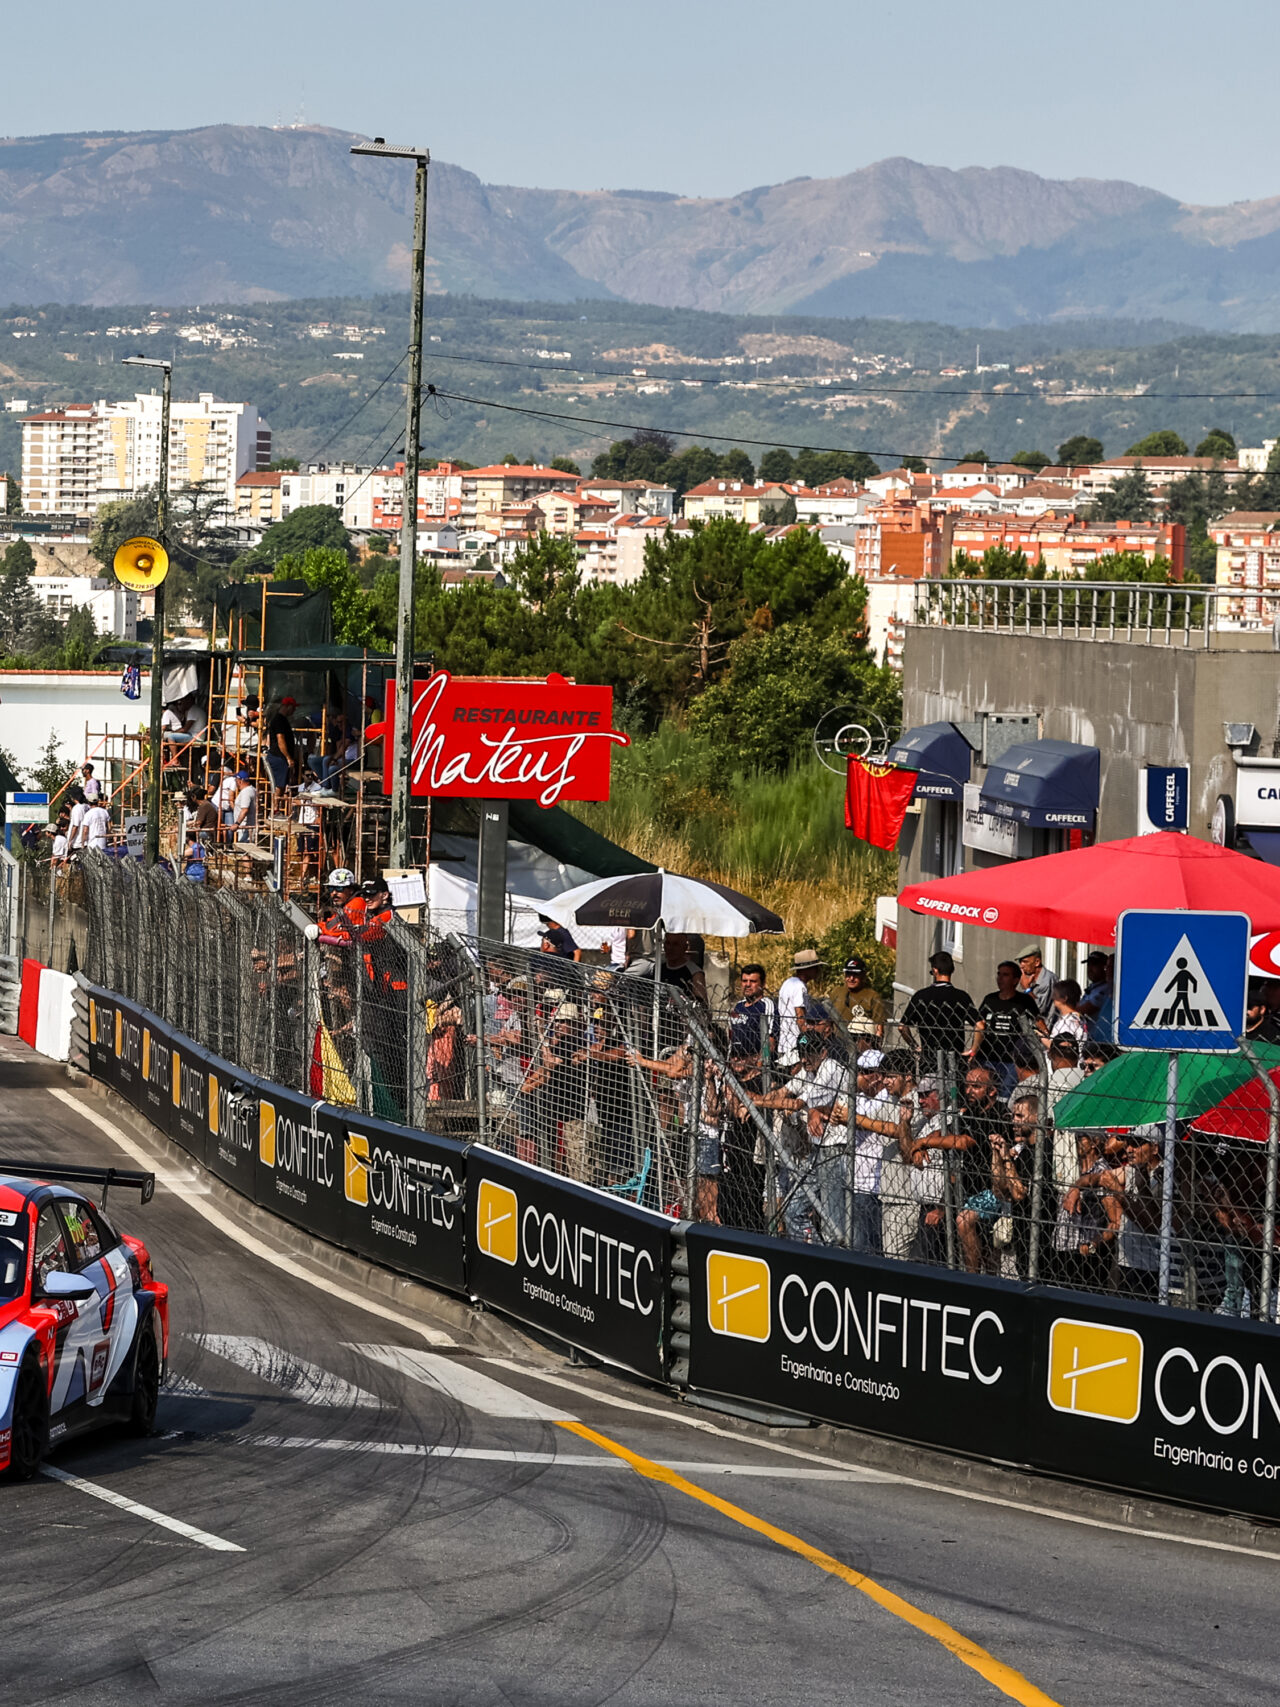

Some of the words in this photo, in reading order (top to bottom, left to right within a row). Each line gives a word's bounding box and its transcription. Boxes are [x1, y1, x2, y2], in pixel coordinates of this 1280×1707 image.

[411, 674, 628, 806] Mateus
[452, 707, 601, 727] RESTAURANTE
[1257, 787, 1280, 800] CA
[600, 899, 648, 909] GOLDEN
[609, 908, 631, 918] BEER
[916, 896, 952, 912] SUPER
[951, 904, 982, 918] BOCK
[276, 1114, 334, 1188] CONFITEC
[370, 1147, 454, 1230] CONFITEC
[522, 1205, 654, 1316] CONFITEC
[523, 1277, 555, 1305] Engenharia
[555, 1295, 560, 1307] e
[561, 1294, 595, 1323] Construção
[778, 1273, 1005, 1385] CONFITEC
[781, 1354, 833, 1385] Engenharia
[835, 1373, 842, 1387] e
[844, 1371, 900, 1401] Construção
[1153, 1437, 1234, 1472] Engenharia
[1237, 1459, 1248, 1474] e
